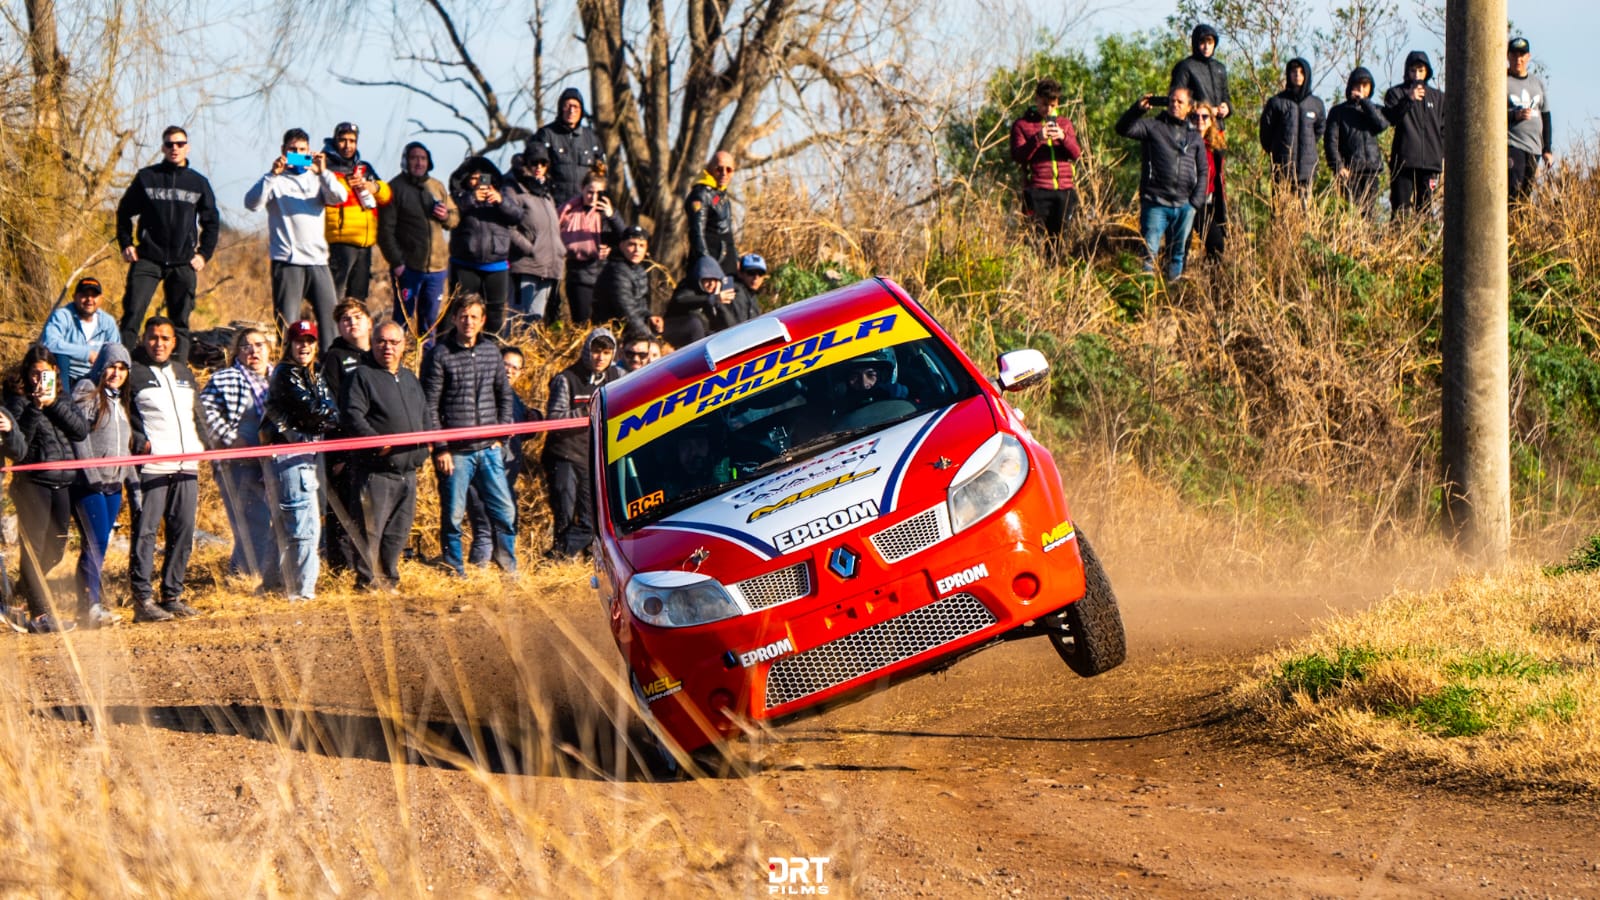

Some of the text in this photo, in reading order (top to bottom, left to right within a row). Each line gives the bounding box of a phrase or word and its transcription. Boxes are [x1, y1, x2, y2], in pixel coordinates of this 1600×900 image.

[616, 314, 897, 442] MANDOLA
[696, 354, 824, 414] RALLY
[629, 492, 663, 519] RC5
[773, 499, 880, 553] EPROM
[1042, 520, 1074, 547] MEL
[936, 563, 989, 595] EPROM
[740, 638, 793, 668] EPROM
[642, 676, 682, 697] MEL
